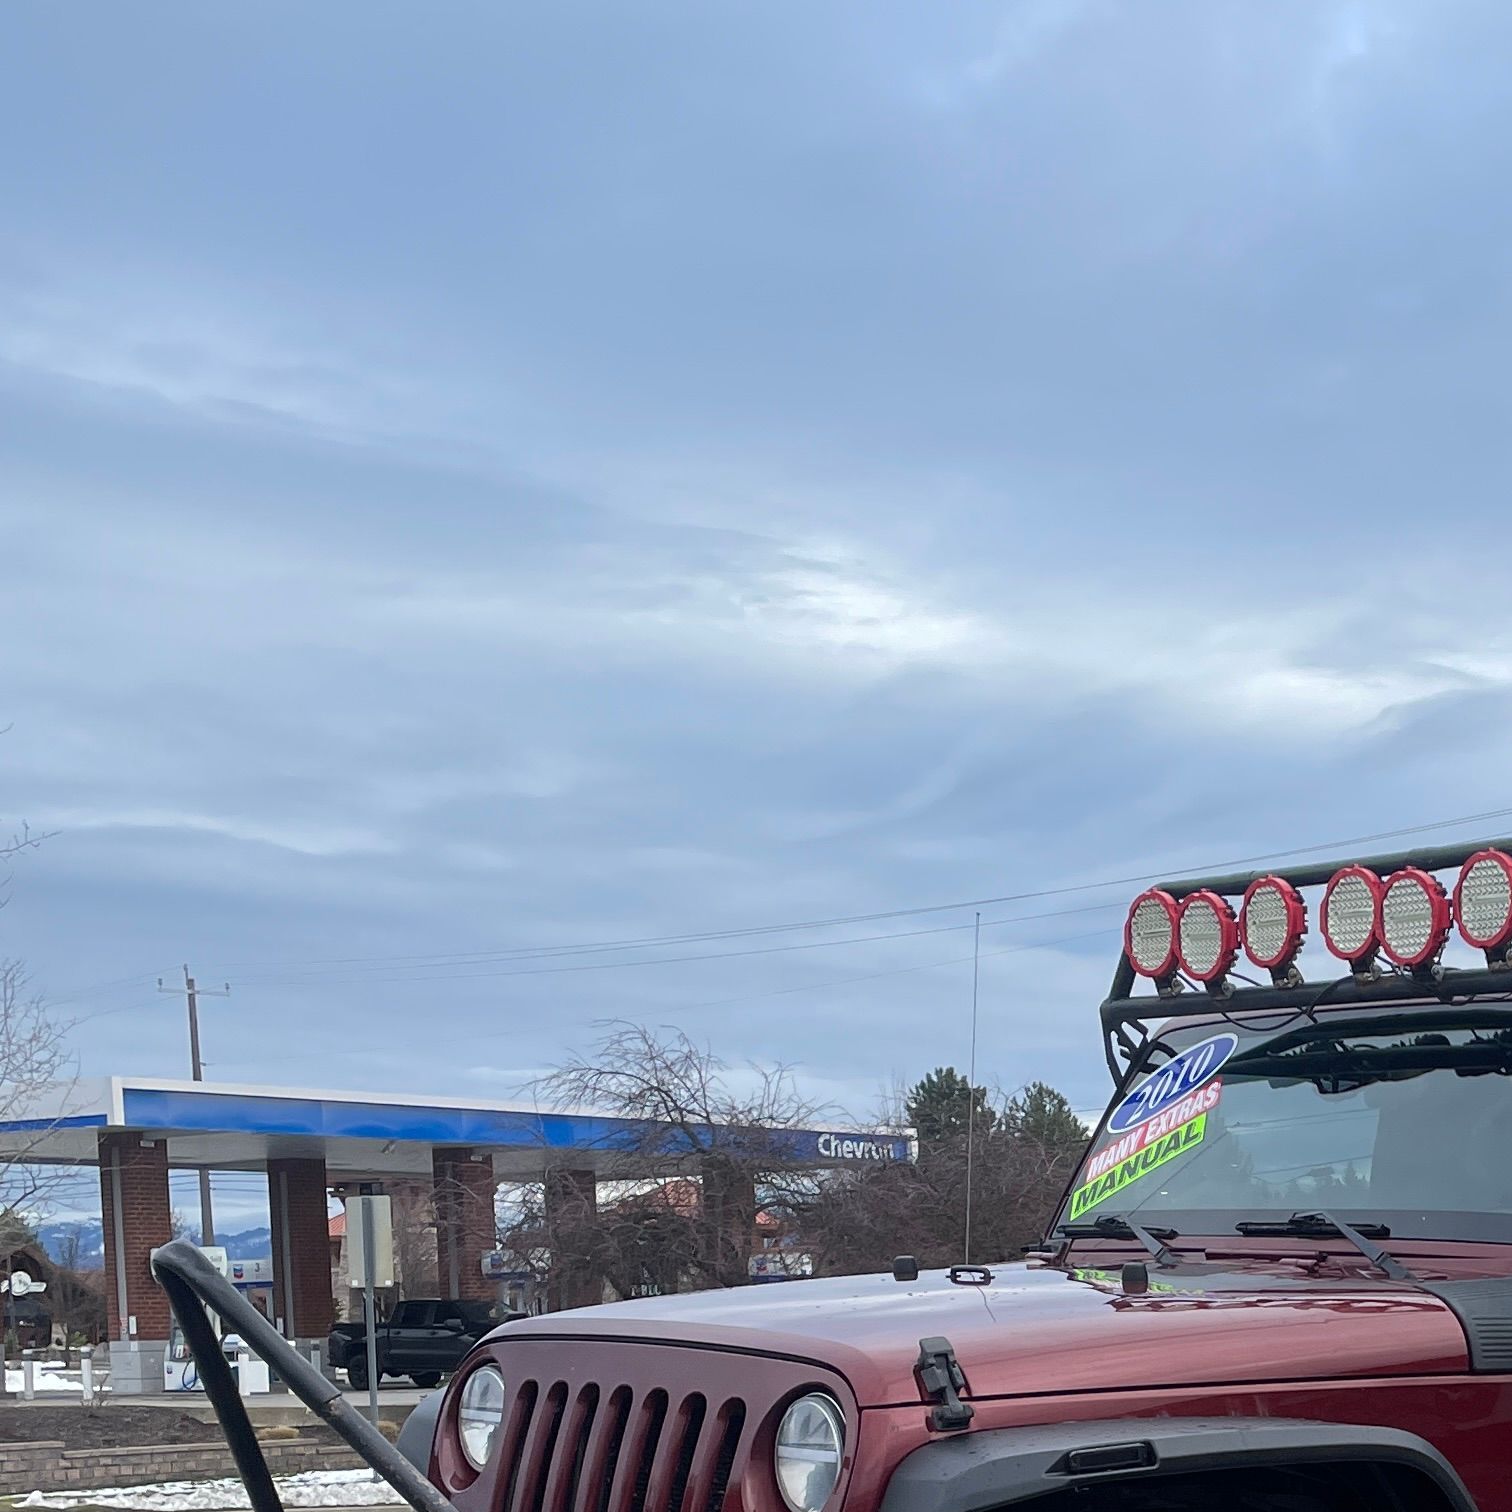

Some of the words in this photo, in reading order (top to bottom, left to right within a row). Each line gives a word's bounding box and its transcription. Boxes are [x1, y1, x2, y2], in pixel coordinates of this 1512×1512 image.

[1125, 1043, 1216, 1127] 2010
[1074, 1123, 1201, 1213] MANUAL
[1086, 1130, 1144, 1181] MANY
[1147, 1081, 1220, 1141] EXTRAS
